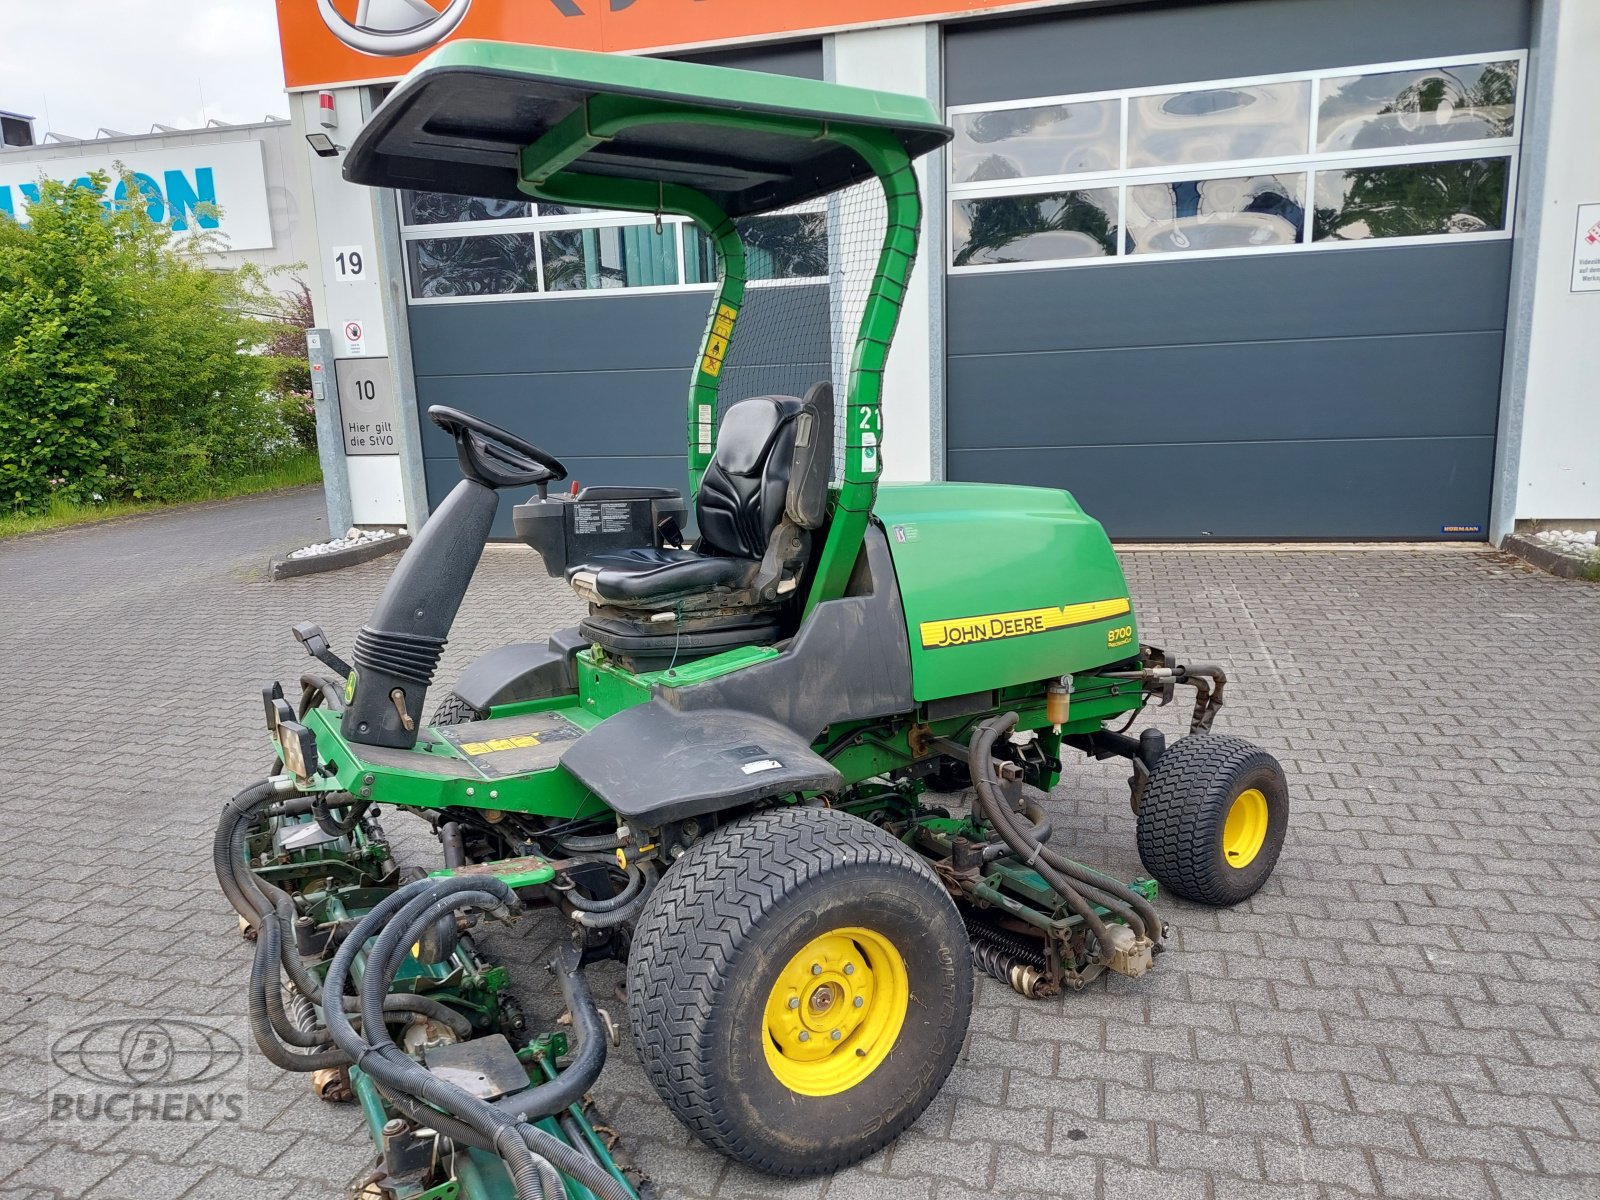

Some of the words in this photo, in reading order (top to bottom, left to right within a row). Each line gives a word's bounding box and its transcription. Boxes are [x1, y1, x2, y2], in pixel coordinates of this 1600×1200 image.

[336, 251, 363, 275] 19
[356, 380, 375, 400] 10
[349, 422, 370, 432] Hier
[376, 422, 392, 434] gilt
[860, 406, 881, 430] 21
[350, 436, 365, 446] die
[369, 435, 394, 446] StVO
[939, 625, 986, 644] JOHN
[990, 616, 1044, 636] DEERE
[1108, 626, 1132, 642] 8700
